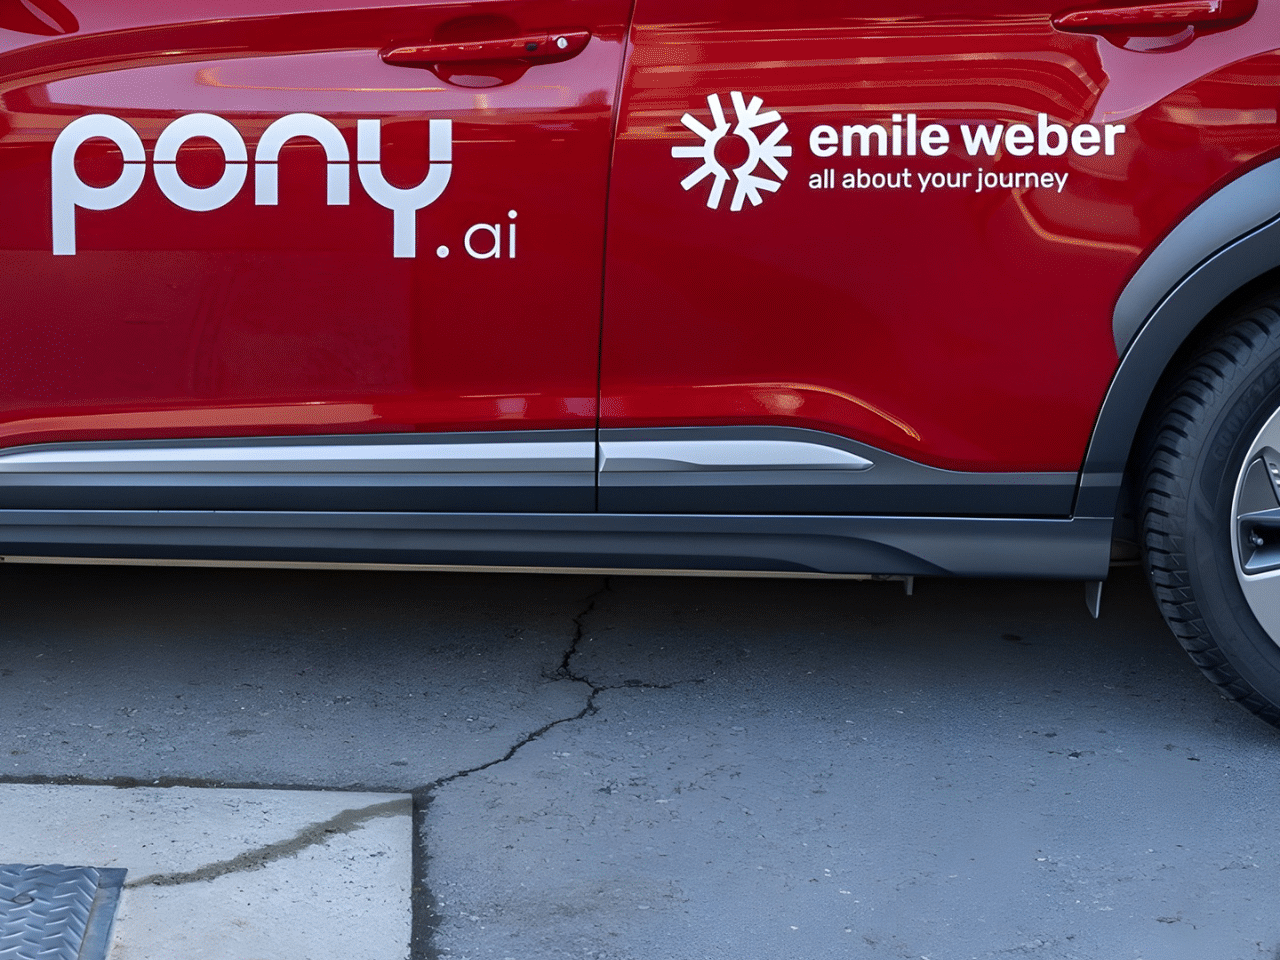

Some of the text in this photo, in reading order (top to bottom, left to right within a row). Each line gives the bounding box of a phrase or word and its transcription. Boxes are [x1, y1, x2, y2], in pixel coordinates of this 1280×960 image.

[809, 113, 1126, 157] emile weber
[51, 113, 518, 259] pony.ai
[808, 168, 1068, 193] all about your journey
